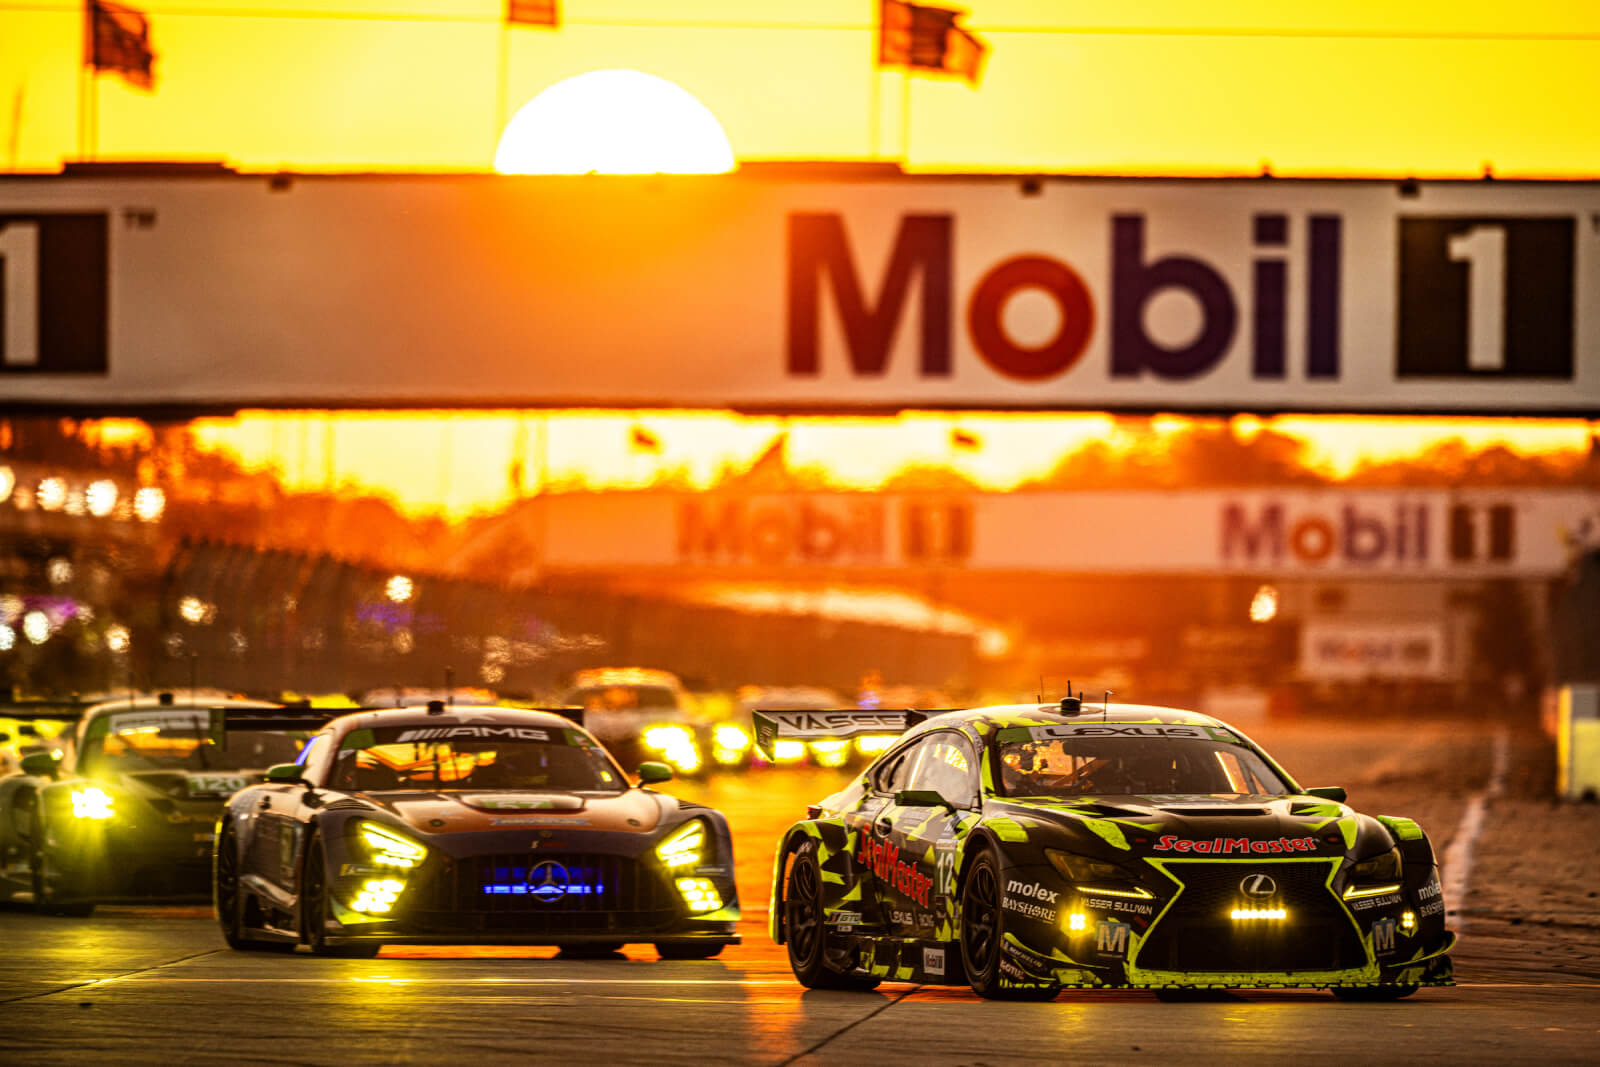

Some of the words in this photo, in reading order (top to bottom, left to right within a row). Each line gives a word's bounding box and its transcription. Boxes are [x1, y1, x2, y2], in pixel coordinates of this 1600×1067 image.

[785, 211, 1343, 382] Mobil
[1449, 226, 1506, 371] 1
[1221, 502, 1429, 563] Mobil
[449, 727, 550, 741] AMG
[1045, 727, 1199, 737] LEXUS
[199, 776, 246, 792] 120
[1152, 835, 1318, 854] SealMaster
[857, 823, 934, 909] SealMaster
[937, 851, 954, 894] 12
[1007, 879, 1059, 905] molex
[1001, 896, 1057, 922] BAYSHORE
[1114, 901, 1153, 915] SULLIVAN
[1097, 924, 1125, 953] M
[1374, 922, 1395, 951] M
